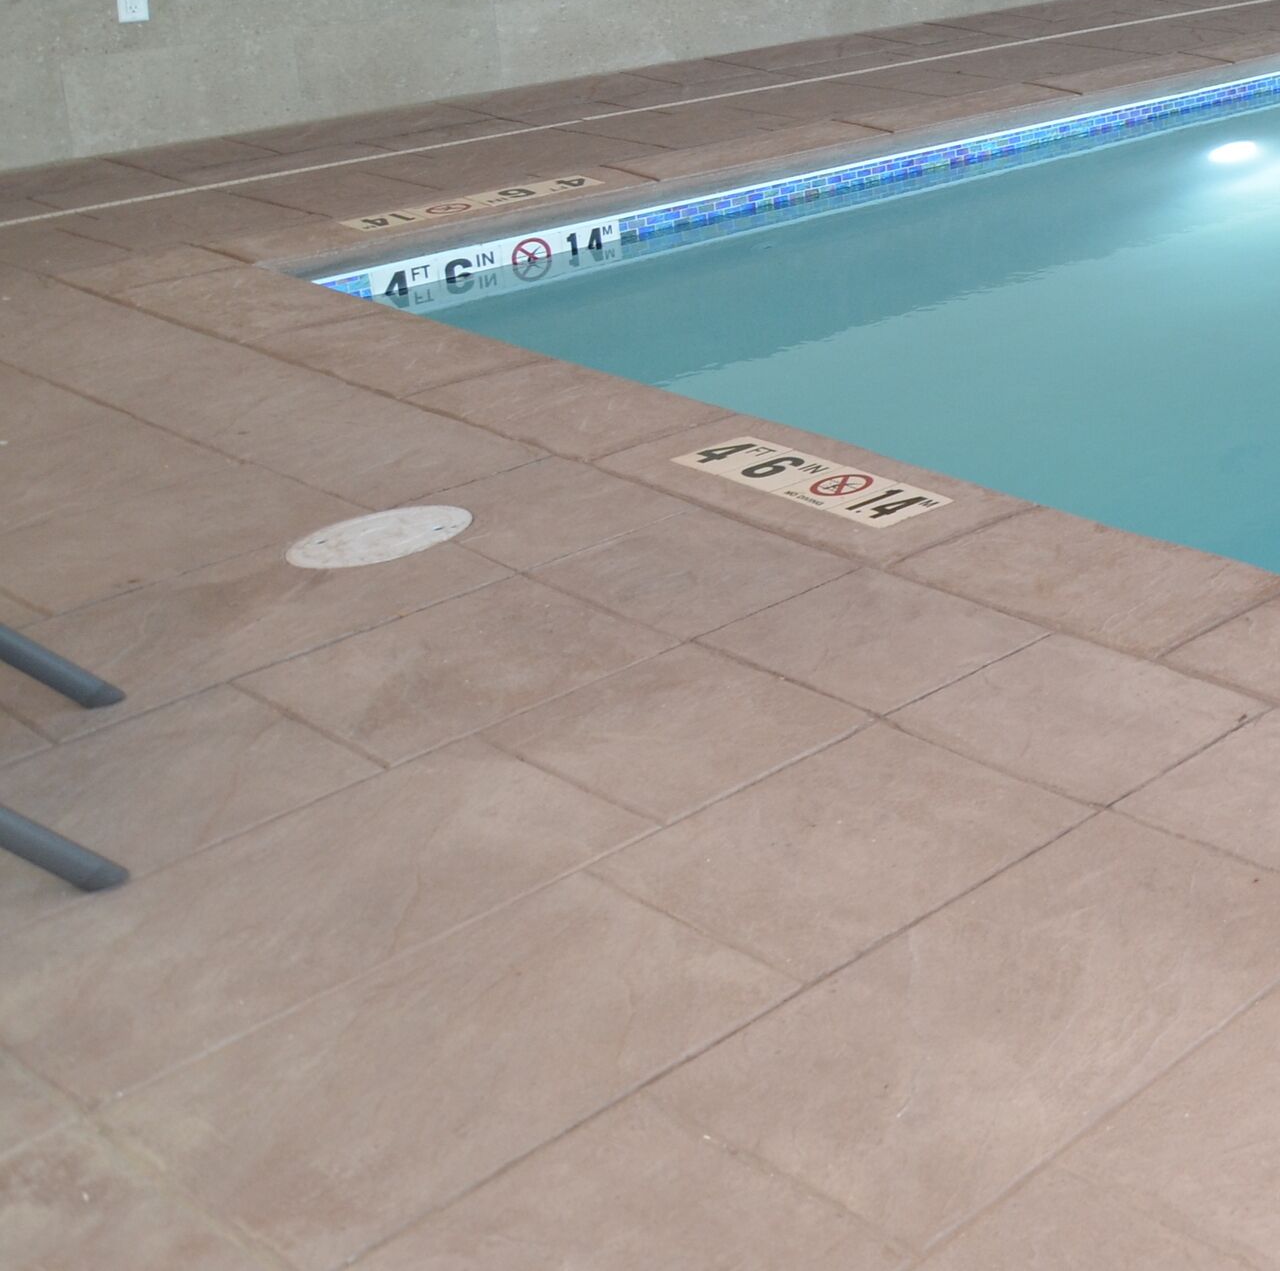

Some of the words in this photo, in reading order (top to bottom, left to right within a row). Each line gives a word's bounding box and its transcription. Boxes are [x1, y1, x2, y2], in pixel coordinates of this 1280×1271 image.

[411, 264, 430, 282] FT
[476, 251, 495, 268] IN
[602, 225, 613, 236] M
[697, 443, 756, 464] 4
[745, 446, 776, 457] FT
[741, 456, 805, 479] 6
[799, 463, 829, 475] IN
[920, 498, 940, 509] M
